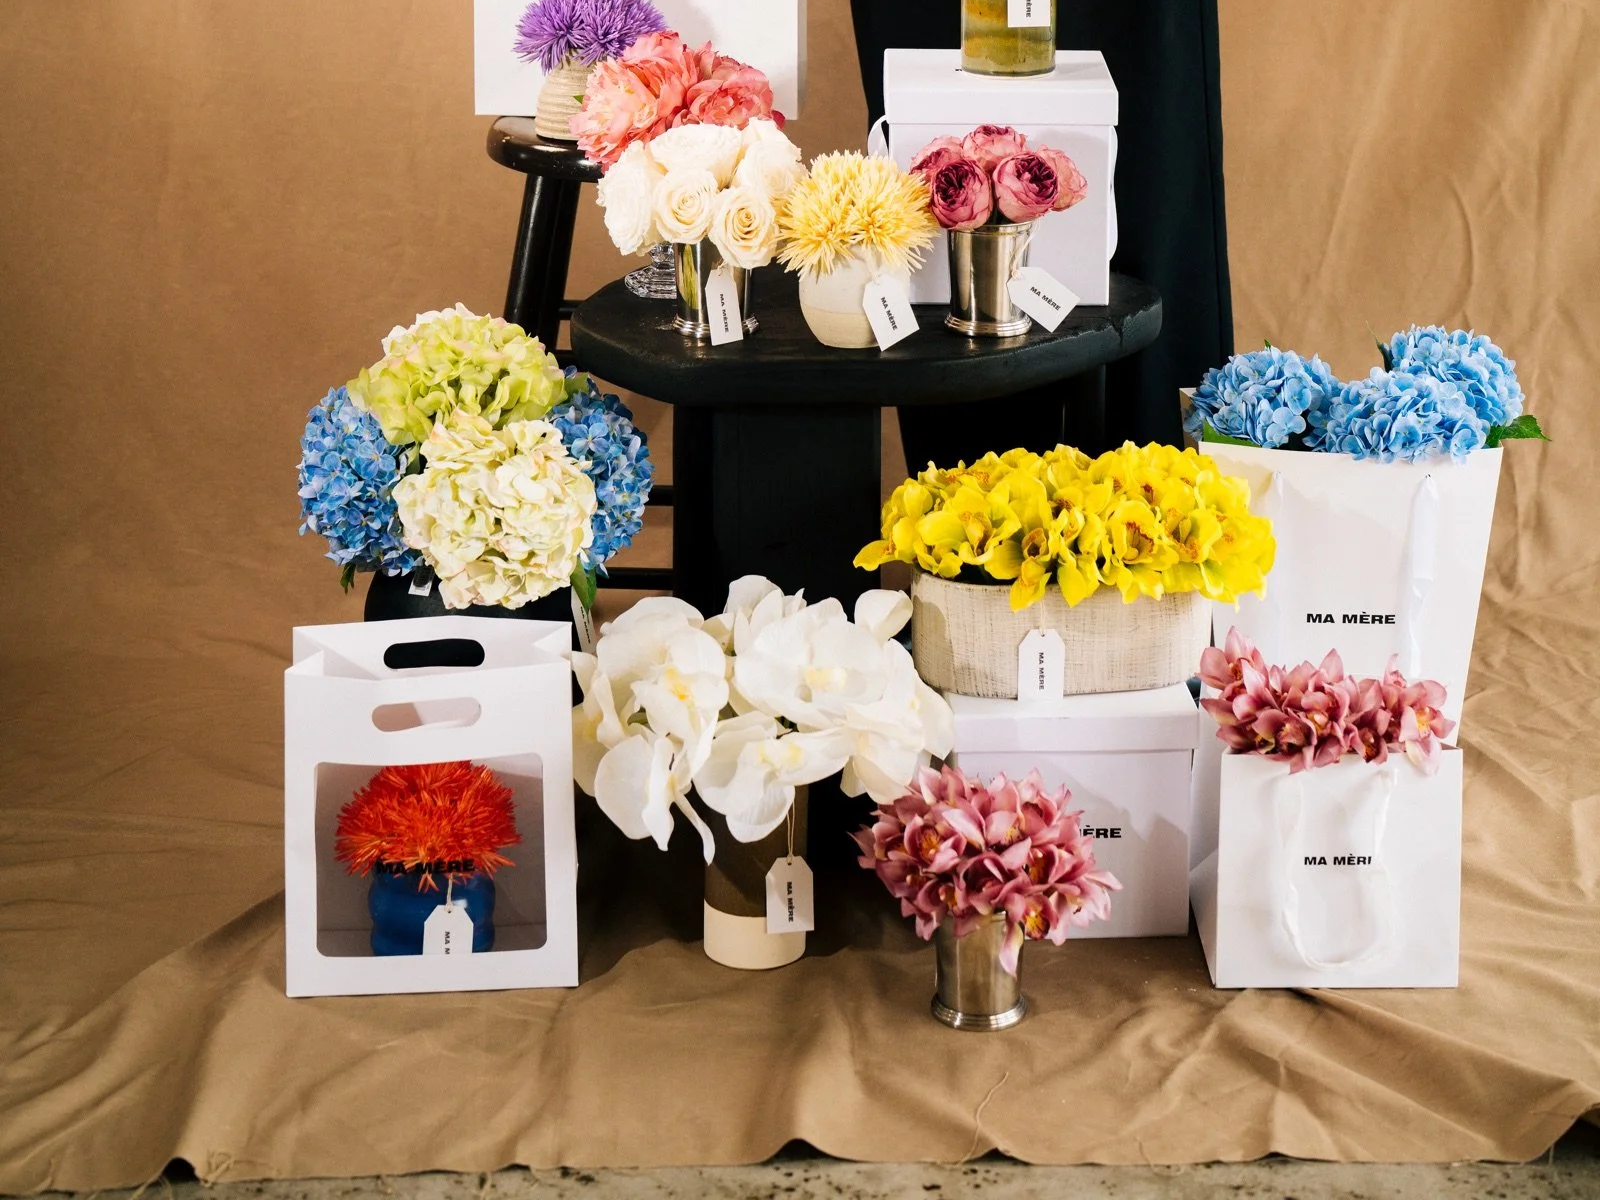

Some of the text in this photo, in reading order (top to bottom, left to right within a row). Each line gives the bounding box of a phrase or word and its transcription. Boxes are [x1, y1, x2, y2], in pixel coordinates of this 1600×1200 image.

[719, 293, 725, 307] MA
[1030, 286, 1061, 311] MA MÈRE
[880, 296, 898, 331] MA MÈRE
[1306, 611, 1396, 624] MA MÈRE
[1038, 652, 1044, 665] MA
[1079, 824, 1122, 839] ÈRE
[1304, 856, 1327, 865] MA
[787, 881, 792, 895] MA
[445, 931, 450, 945] MA
